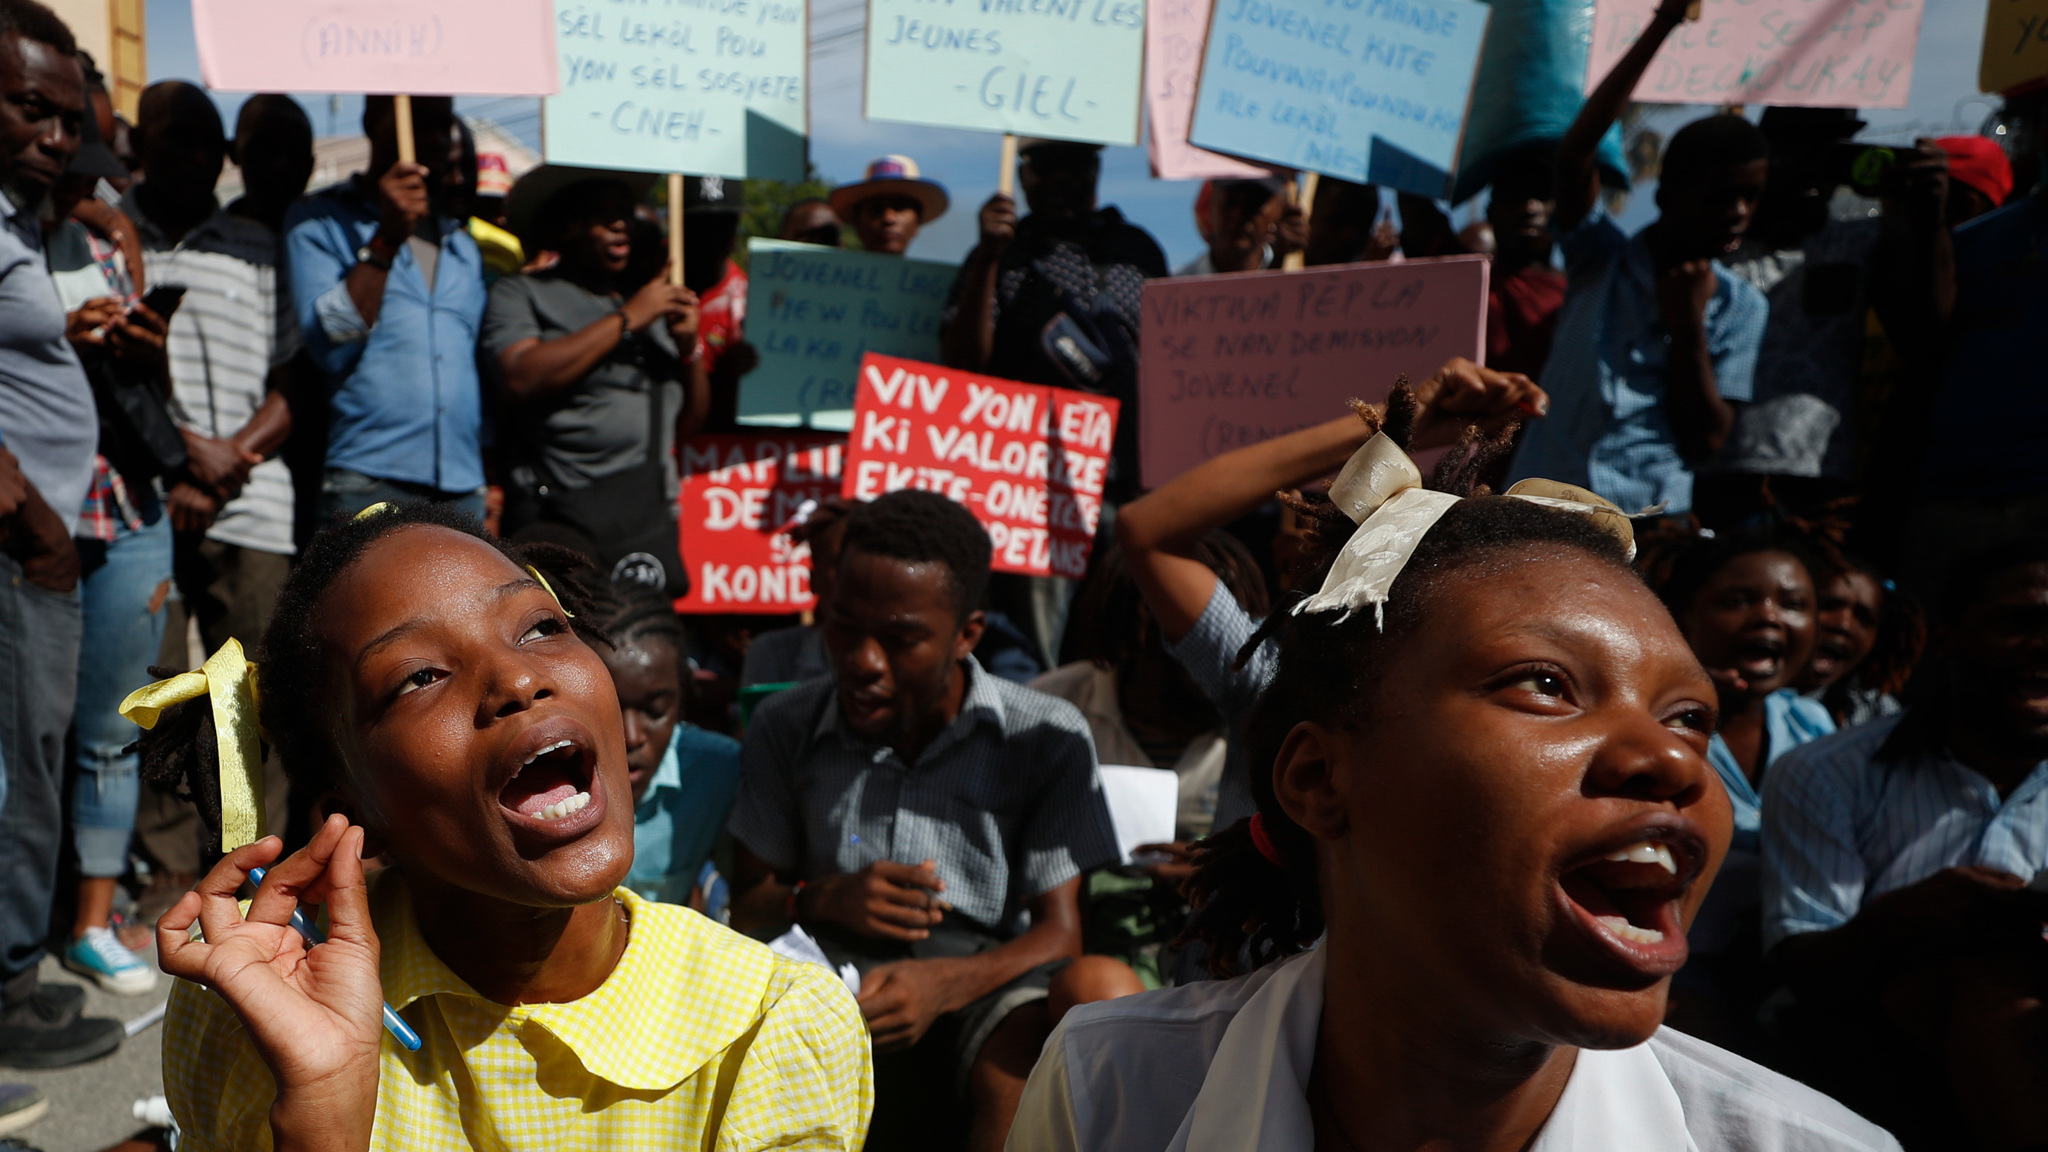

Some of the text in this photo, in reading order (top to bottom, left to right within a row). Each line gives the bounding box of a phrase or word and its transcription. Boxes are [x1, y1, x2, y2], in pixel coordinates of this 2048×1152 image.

[716, 25, 767, 57] POU
[886, 14, 1003, 55] JEUNES
[1226, 0, 1353, 57] JOVENEL
[1361, 32, 1438, 78] KITE
[563, 53, 618, 88] YON
[760, 248, 882, 292] JOVENEL
[1369, 277, 1427, 312] LA
[1158, 332, 1199, 362] SE
[1213, 328, 1283, 360] NAN
[864, 364, 1113, 454] VIV YON LETA
[925, 423, 1107, 496] VALORIZE
